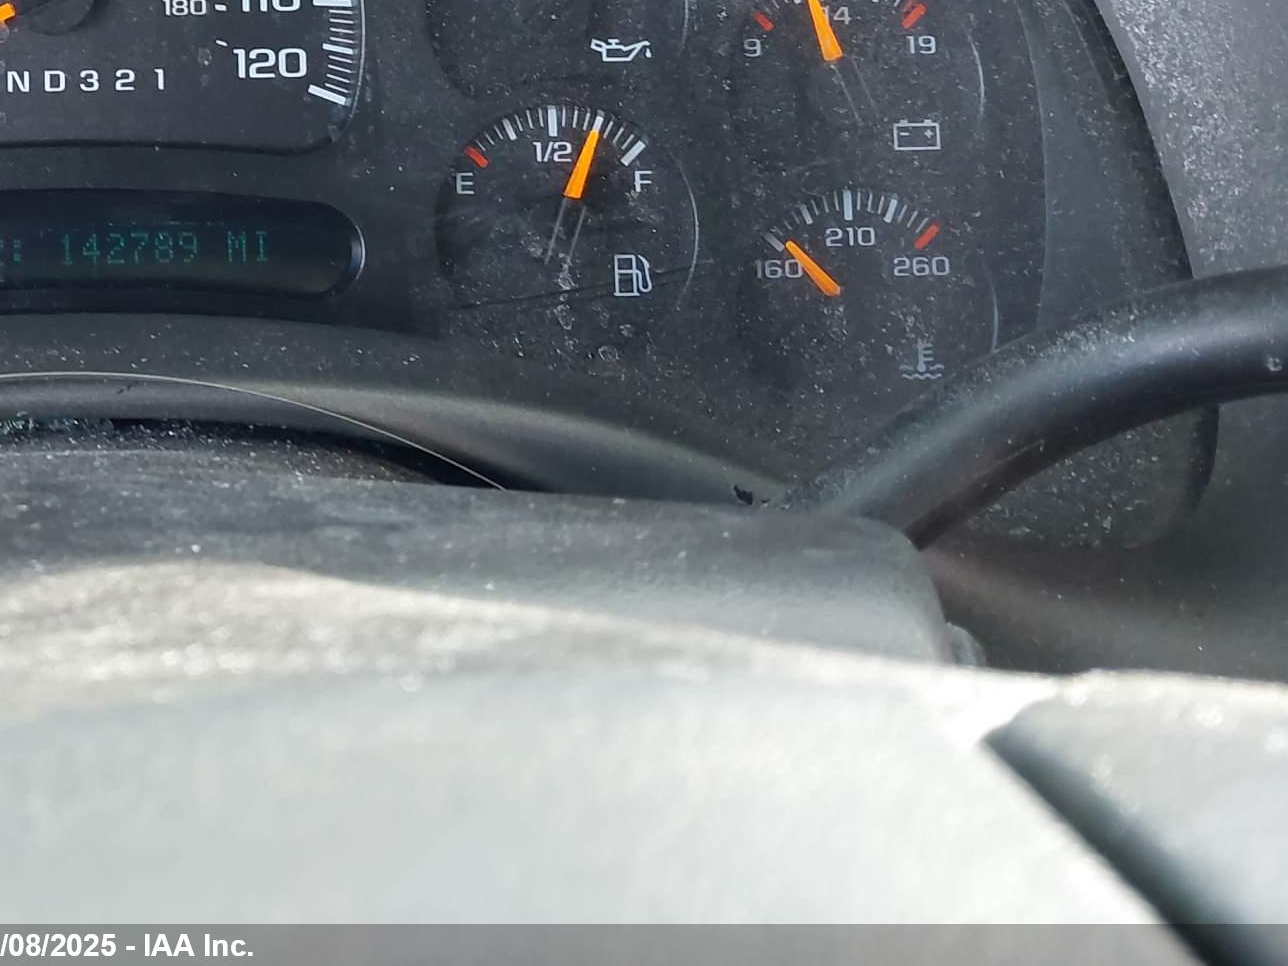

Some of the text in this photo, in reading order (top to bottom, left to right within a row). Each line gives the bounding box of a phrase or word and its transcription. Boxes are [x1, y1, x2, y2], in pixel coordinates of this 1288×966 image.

[743, 38, 762, 58] 9
[907, 36, 936, 55] 19
[234, 49, 307, 78] 120
[7, 70, 29, 92] N
[44, 70, 66, 91] D
[79, 70, 99, 91] 3
[115, 70, 135, 90] 2
[155, 69, 165, 90] 1
[533, 141, 572, 163] 1/2
[456, 173, 474, 194] E
[635, 171, 652, 192] F
[825, 227, 876, 247] 210
[61, 232, 198, 266] 142789
[228, 231, 269, 262] MI
[755, 259, 803, 278] 160
[893, 256, 950, 276] 260
